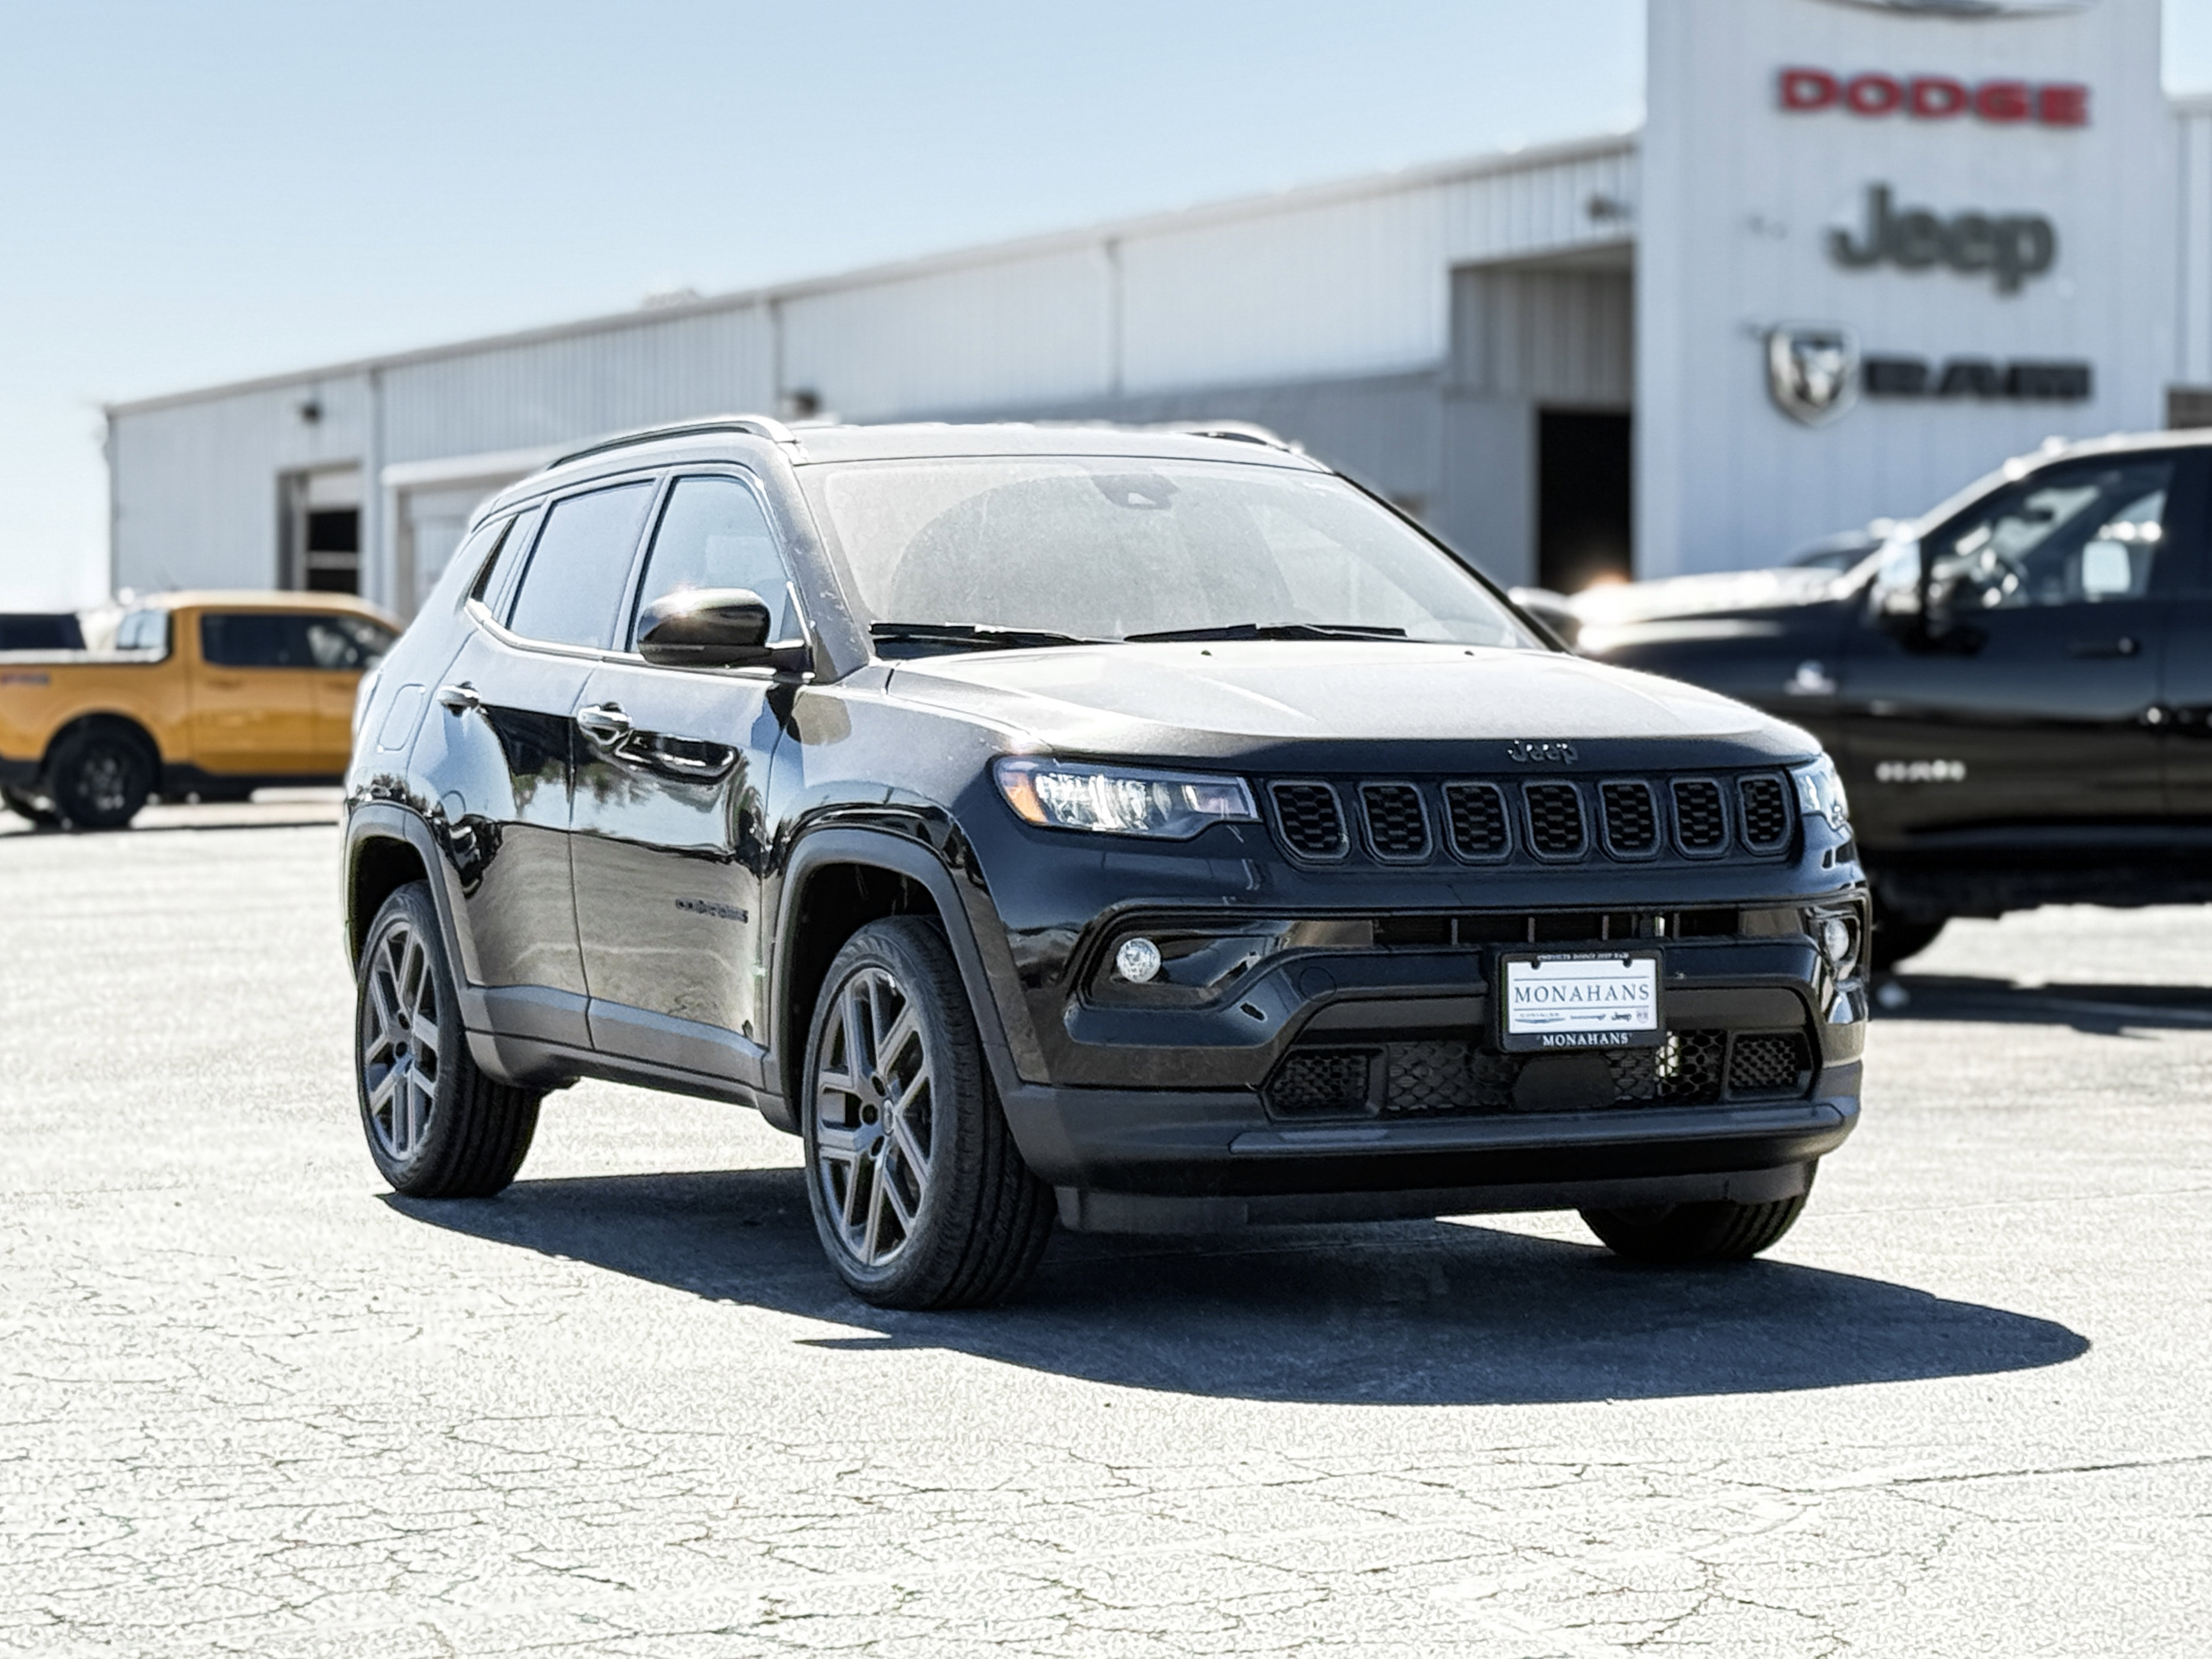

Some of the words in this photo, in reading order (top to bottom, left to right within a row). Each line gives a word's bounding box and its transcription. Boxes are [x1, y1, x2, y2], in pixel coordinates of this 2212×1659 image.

[1778, 66, 2091, 127] DODGE
[1826, 182, 2056, 296] Jeep
[1863, 358, 2091, 400] RAM
[1508, 739, 1579, 765] Jeep
[1514, 984, 1650, 1003] MONAHANS
[1542, 1033, 1628, 1046] MONAHANS
